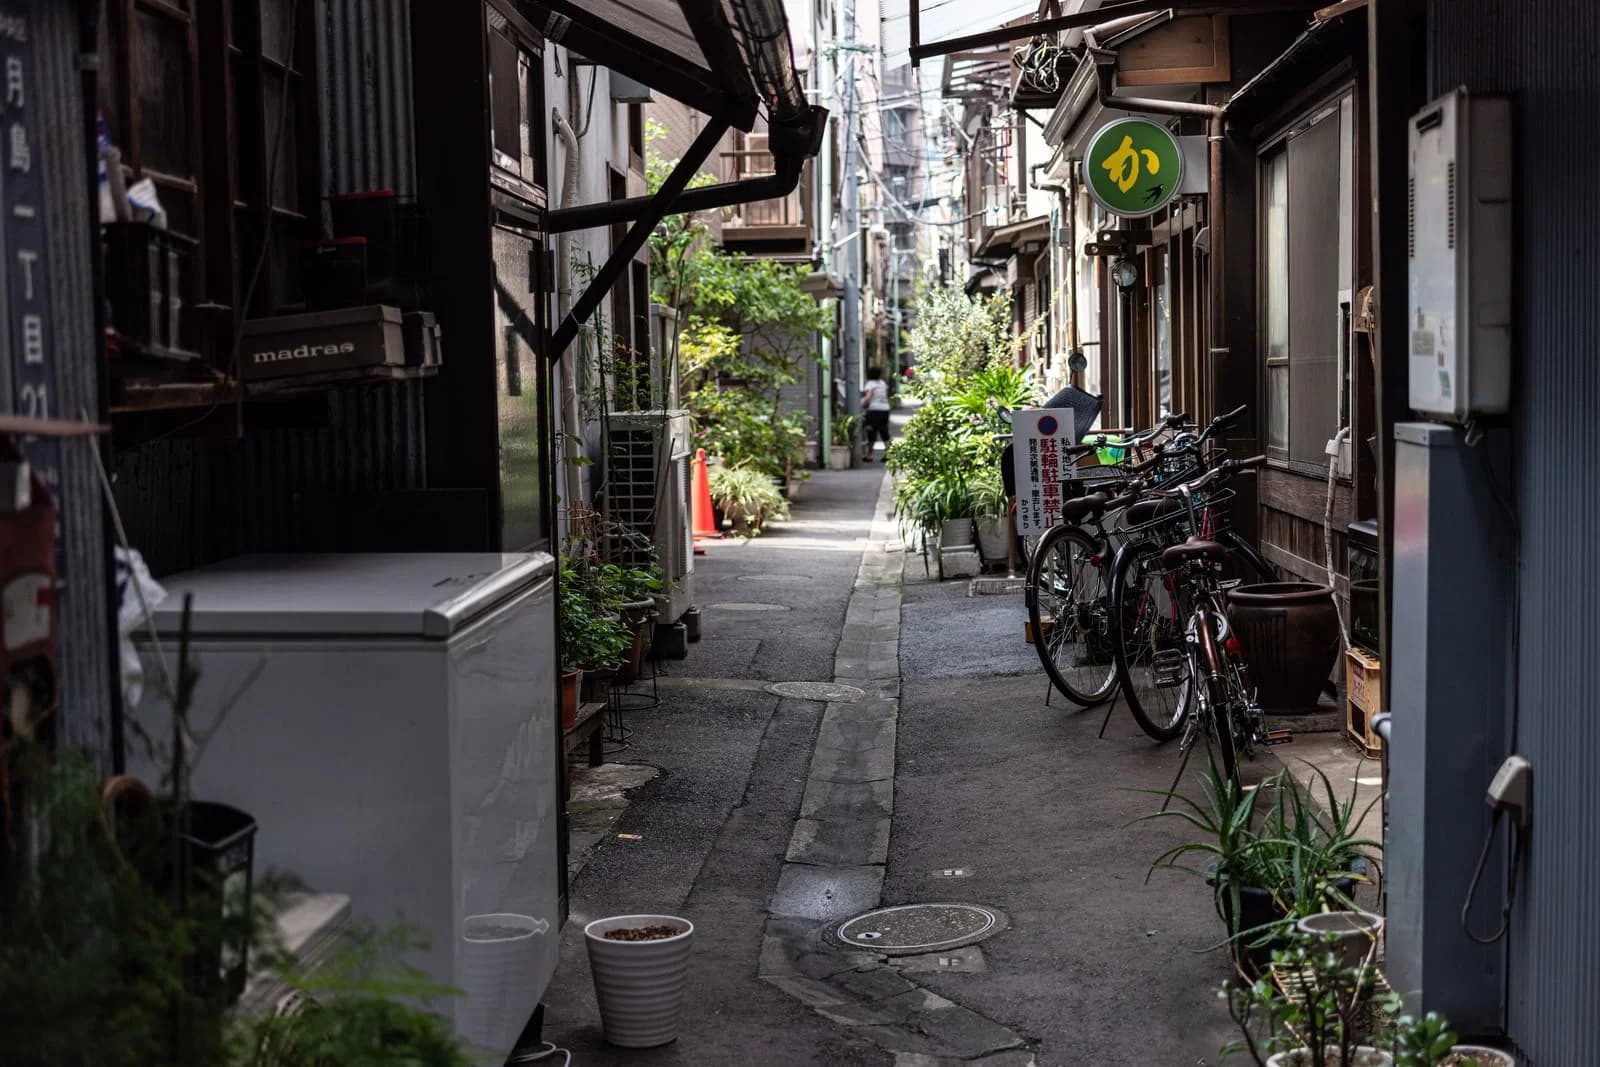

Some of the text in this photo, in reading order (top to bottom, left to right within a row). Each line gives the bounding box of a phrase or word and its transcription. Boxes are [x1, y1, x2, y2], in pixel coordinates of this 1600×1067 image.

[1102, 135, 1160, 193] か
[252, 341, 355, 364] madras
[1040, 438, 1061, 529] 駐輪駐車禁止
